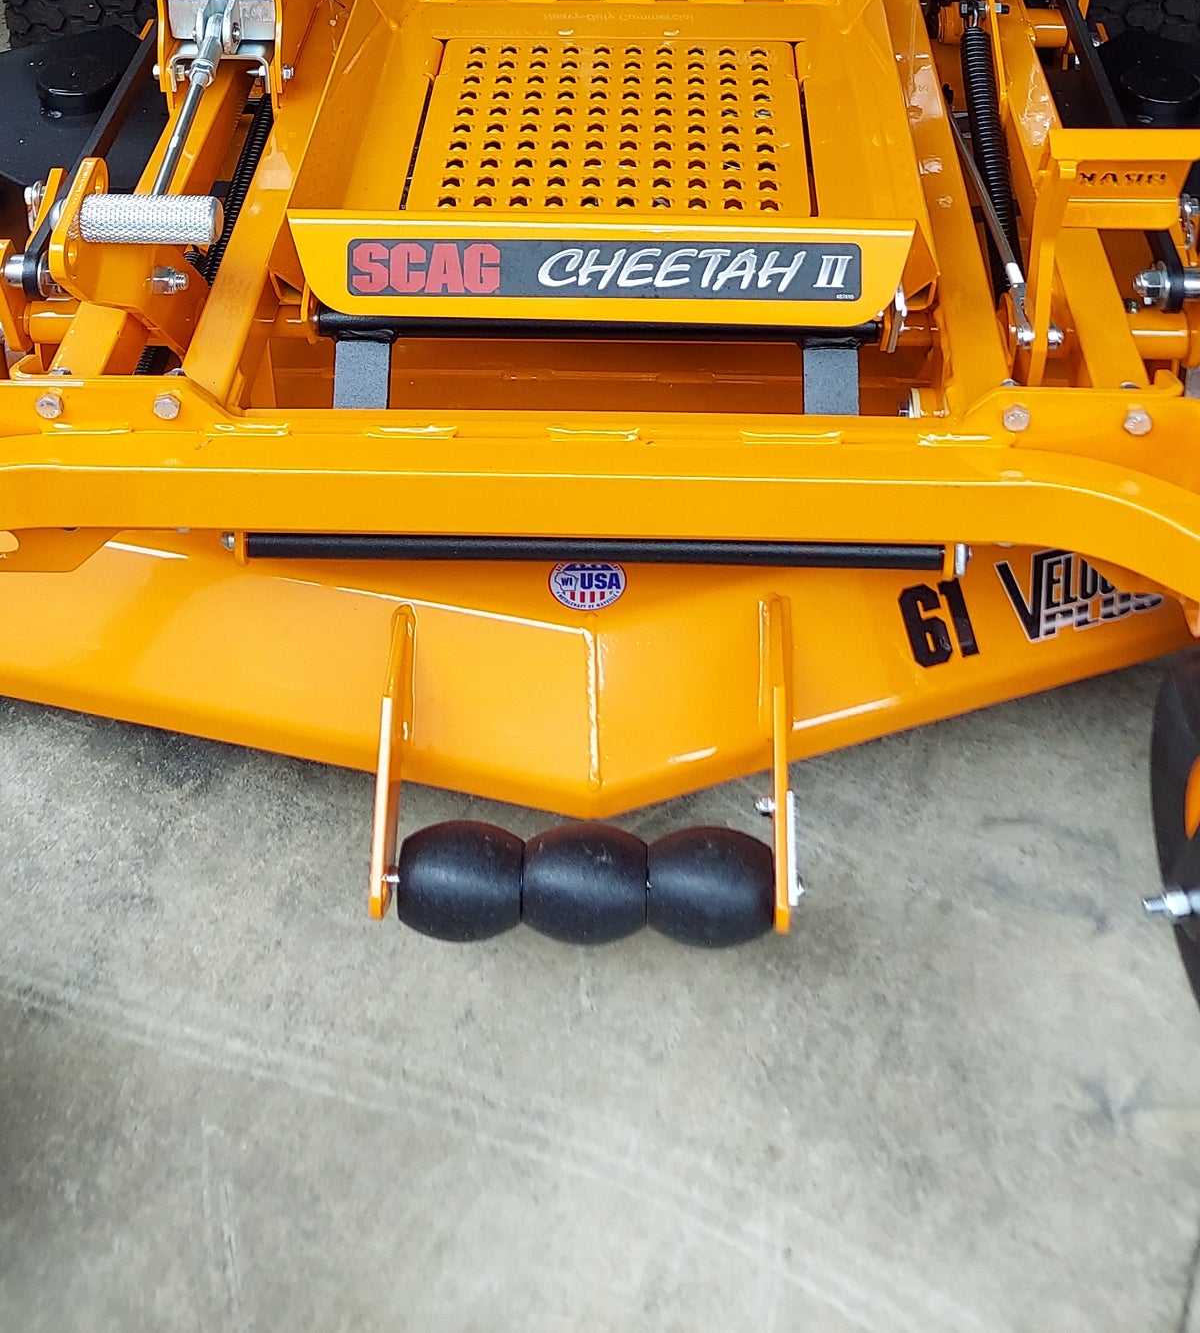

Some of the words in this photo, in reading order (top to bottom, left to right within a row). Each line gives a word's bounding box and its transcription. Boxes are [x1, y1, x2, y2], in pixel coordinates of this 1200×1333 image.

[352, 243, 500, 293] SCAG
[538, 248, 807, 292] CHEETAH
[813, 256, 853, 288] II
[561, 577, 572, 586] WI
[580, 573, 621, 589] USA
[898, 577, 980, 668] 61
[1042, 593, 1166, 639] PLUS
